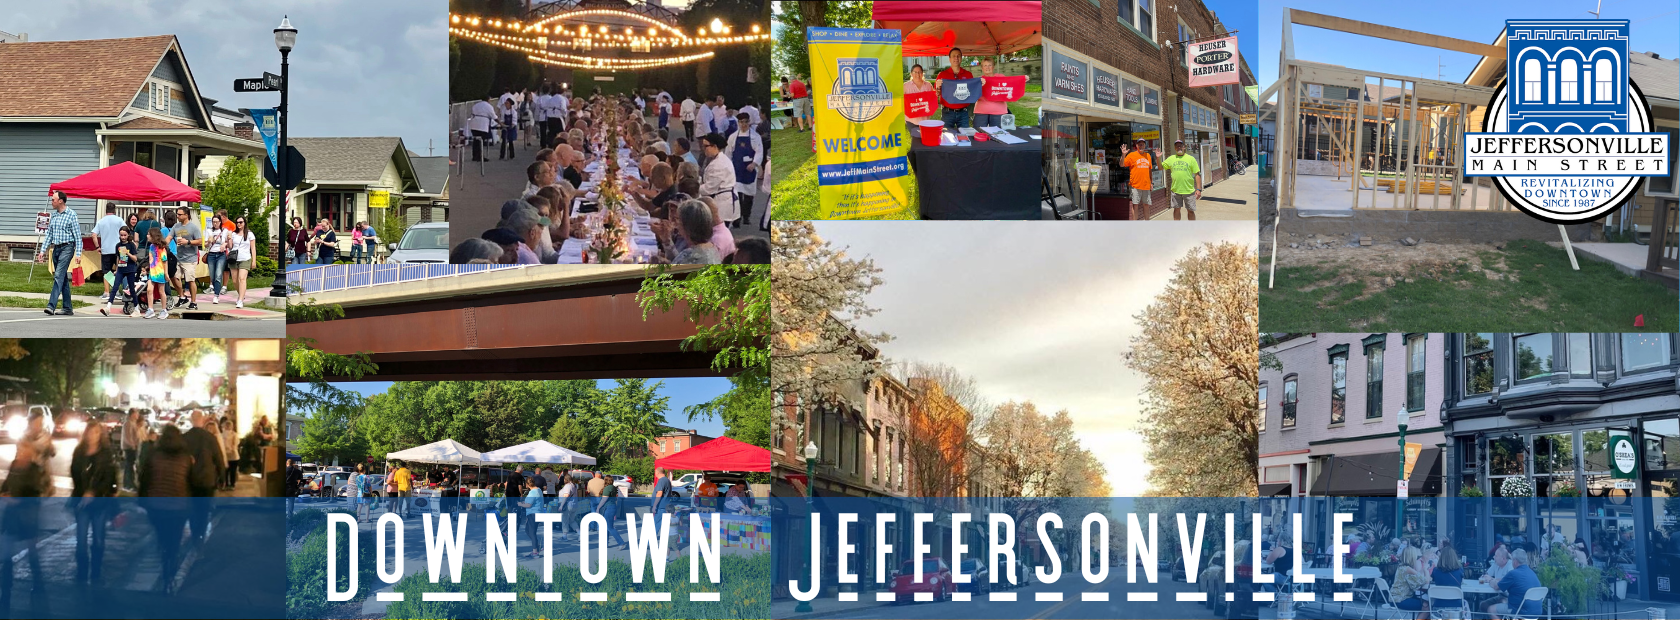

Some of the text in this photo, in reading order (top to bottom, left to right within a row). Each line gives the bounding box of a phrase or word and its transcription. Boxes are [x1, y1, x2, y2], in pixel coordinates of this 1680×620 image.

[1199, 40, 1226, 52] HEUSER
[1196, 52, 1230, 63] PORTER
[1061, 62, 1079, 77] PAINTS
[1192, 63, 1235, 76] HARDWARE
[268, 75, 279, 87] Pearl
[1055, 77, 1084, 94] VARNISHES
[829, 94, 890, 102] JEFFERSONVILLE
[822, 132, 903, 153] WELCOME
[822, 163, 905, 178] www.JeffMainStreet.org
[1615, 451, 1635, 459] O'SHEA'S
